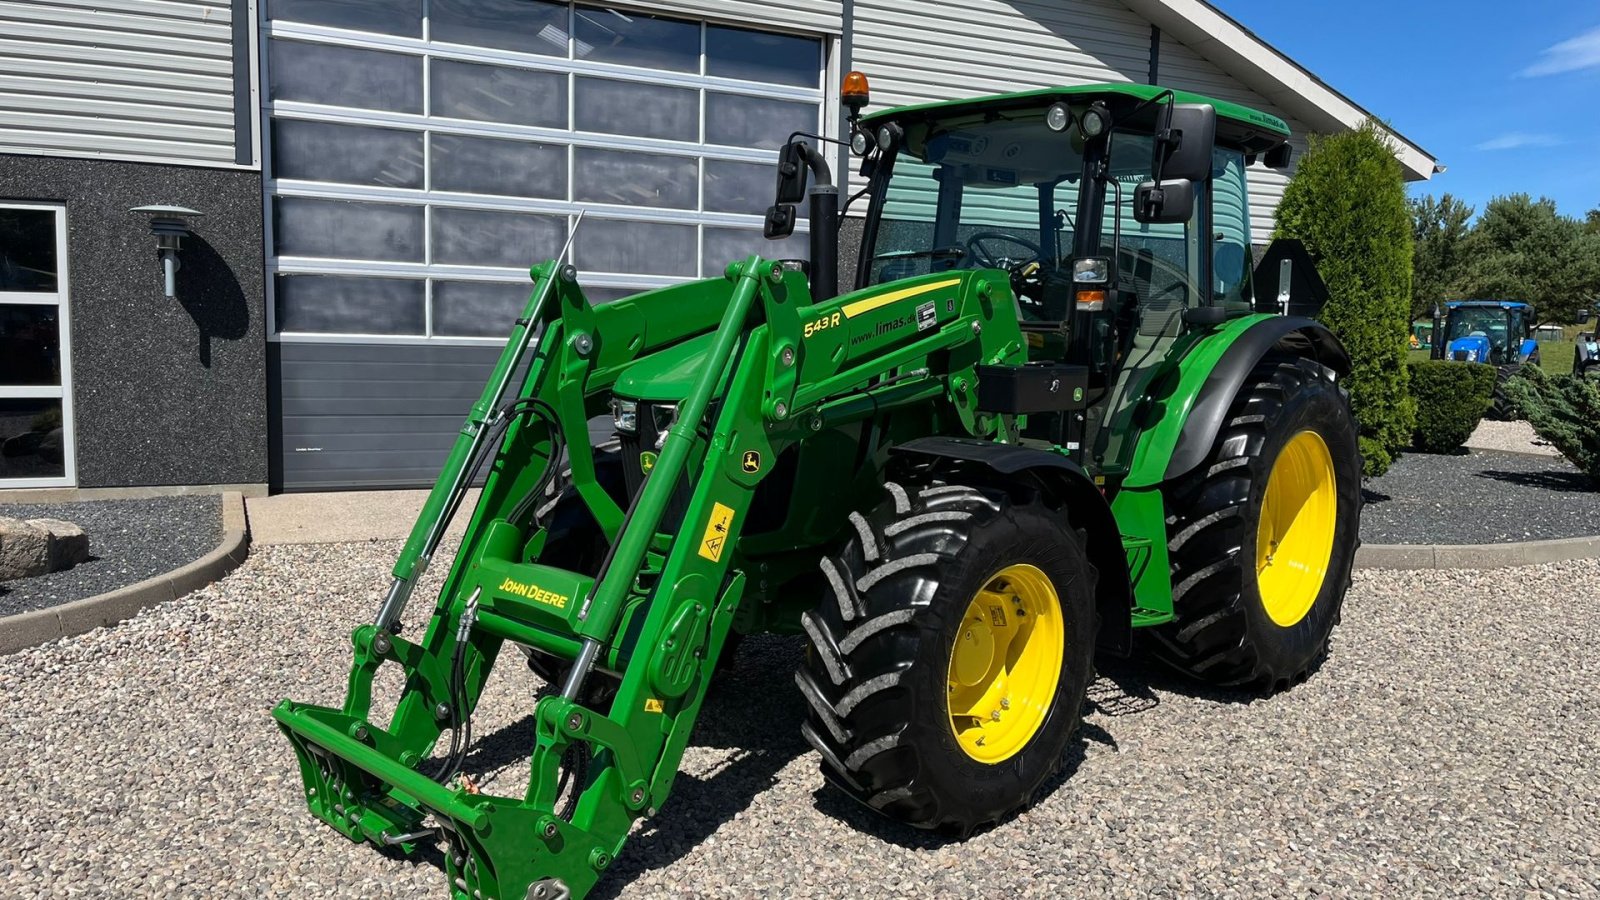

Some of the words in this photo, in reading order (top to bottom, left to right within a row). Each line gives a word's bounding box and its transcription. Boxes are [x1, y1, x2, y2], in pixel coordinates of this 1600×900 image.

[804, 316, 829, 338] 543
[830, 312, 841, 328] R
[499, 577, 528, 597] JOHN
[526, 584, 568, 609] DEERE
